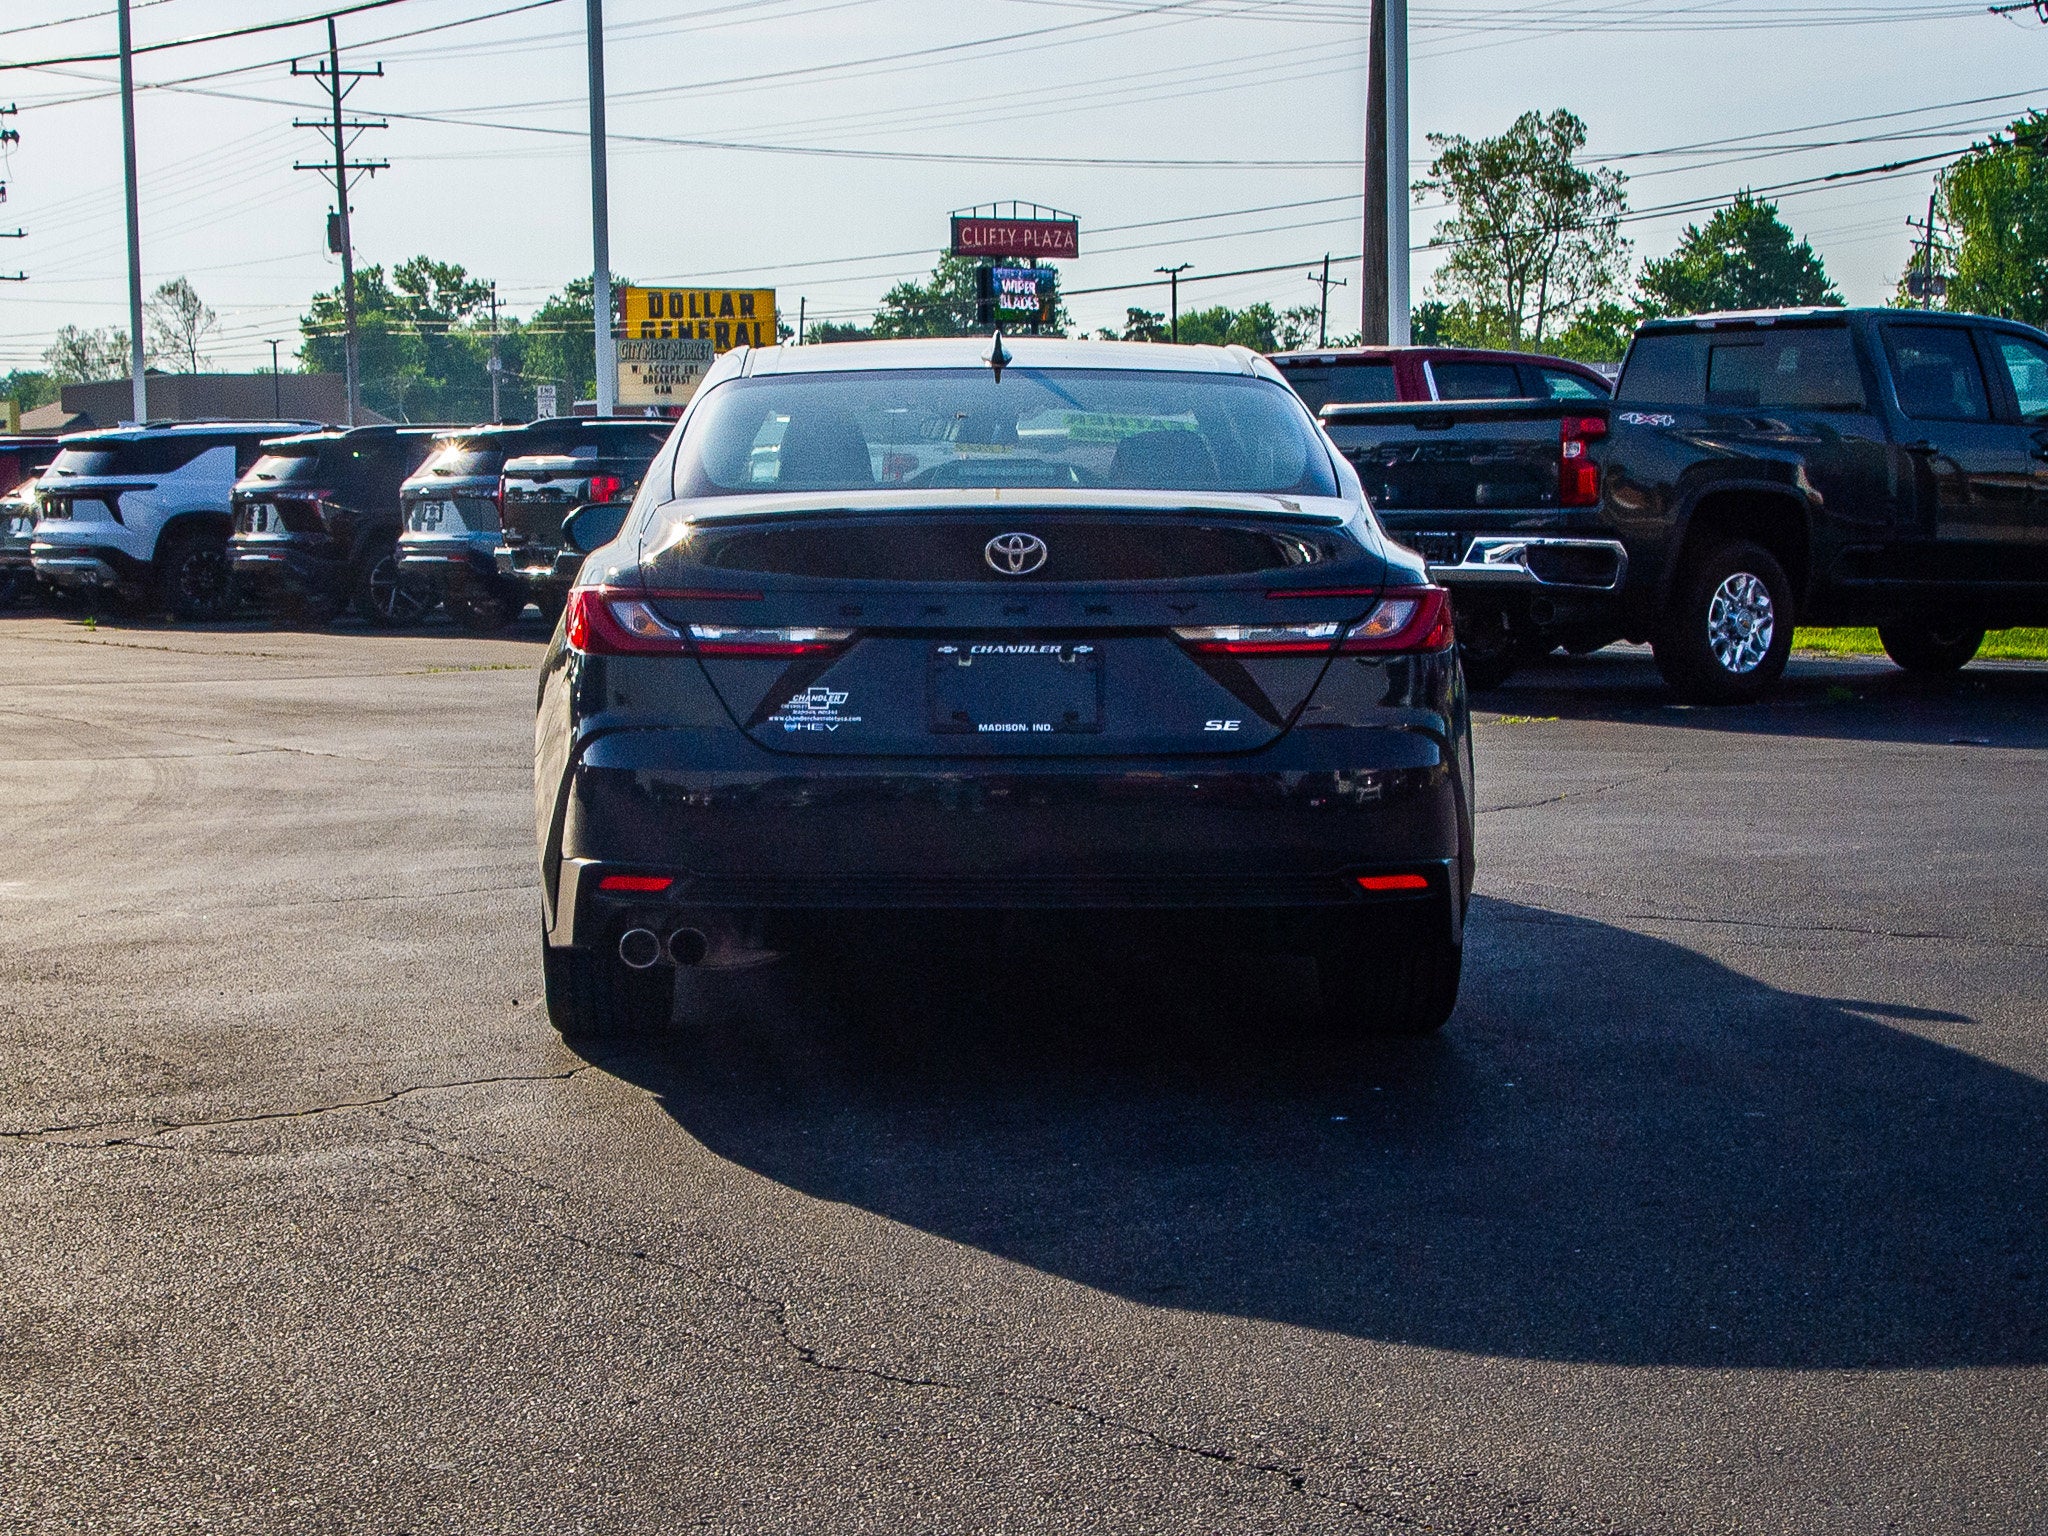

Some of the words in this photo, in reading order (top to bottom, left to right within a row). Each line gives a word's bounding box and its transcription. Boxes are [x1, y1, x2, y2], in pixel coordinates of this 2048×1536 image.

[961, 227, 1017, 246] CLIFTY
[1024, 229, 1075, 248] PLAZA
[1001, 279, 1037, 294] WIPER
[648, 291, 756, 319] DOLLAR
[999, 295, 1040, 309] BLADES
[620, 342, 643, 361] CITY
[645, 343, 671, 361] MEAT
[672, 343, 711, 361] MARKET
[648, 364, 681, 374] ACCEPT
[684, 365, 699, 375] EBT
[643, 375, 691, 384] BREAKFAST
[654, 385, 672, 395] 6AM
[970, 645, 1062, 654] CHANDLER
[792, 694, 841, 702] CHANDLER
[1032, 723, 1054, 732] IND.
[1204, 720, 1242, 731] SE
